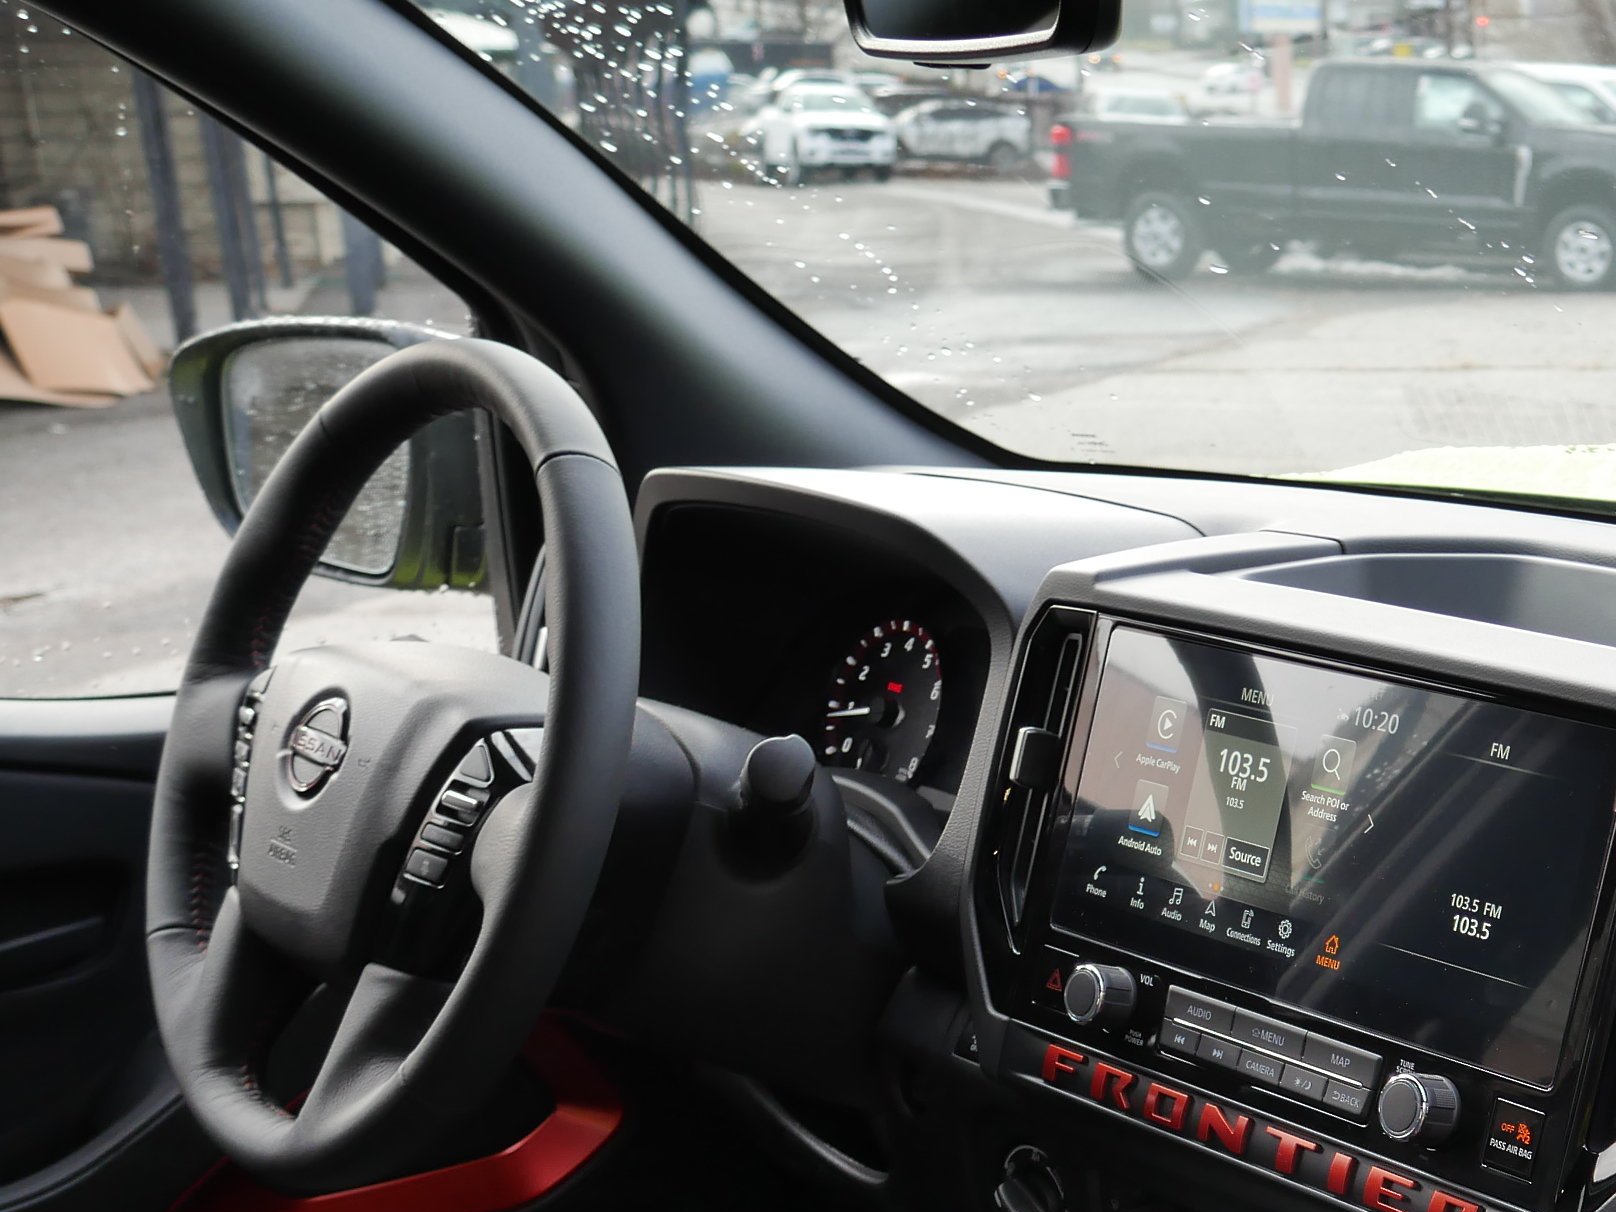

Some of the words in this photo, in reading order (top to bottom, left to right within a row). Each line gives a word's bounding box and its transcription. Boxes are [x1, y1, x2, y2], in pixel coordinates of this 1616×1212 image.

[880, 642, 892, 657] 3
[904, 637, 915, 651] 4
[922, 654, 933, 669] 5
[858, 665, 870, 681] 2
[930, 685, 941, 700] 6
[1241, 687, 1274, 706] MENU
[1209, 714, 1226, 729] FM
[1354, 706, 1400, 735] 10:20
[841, 737, 853, 753] 0
[1490, 742, 1511, 760] FM
[1136, 753, 1155, 767] Apple
[1156, 758, 1181, 774] CarPlay
[1219, 748, 1271, 783] 103.5
[1231, 777, 1248, 791] FM
[1226, 796, 1245, 810] 103.5
[1301, 790, 1326, 806] Search
[1326, 797, 1340, 809] POI
[1340, 802, 1350, 811] or
[1307, 806, 1338, 822] Address
[1117, 835, 1145, 853] Android
[1145, 843, 1162, 856] Auto
[1229, 847, 1262, 867] Source
[1086, 883, 1107, 898] Phone
[1130, 897, 1145, 910] Info
[1450, 893, 1480, 913] 103.5
[1483, 902, 1503, 920] FM
[1161, 907, 1182, 922] Audio
[1199, 919, 1216, 933] Map
[1452, 914, 1492, 940] 103.5
[1226, 927, 1261, 946] Connections
[1266, 939, 1296, 958] Settings
[1315, 954, 1341, 971] MENU
[1140, 973, 1154, 987] VOL
[1187, 1005, 1212, 1021] AUDIO
[1124, 1034, 1144, 1047] POWER
[1260, 1029, 1285, 1047] MENU
[1330, 1053, 1350, 1068] MAP
[1400, 1059, 1415, 1070] TUNE
[1245, 1060, 1275, 1078] CAMERA
[1340, 1093, 1360, 1108] BACK
[1501, 1122, 1515, 1134] OFF
[1489, 1137, 1506, 1151] PASS
[1506, 1144, 1518, 1155] AIR
[1518, 1147, 1533, 1160] BAG
